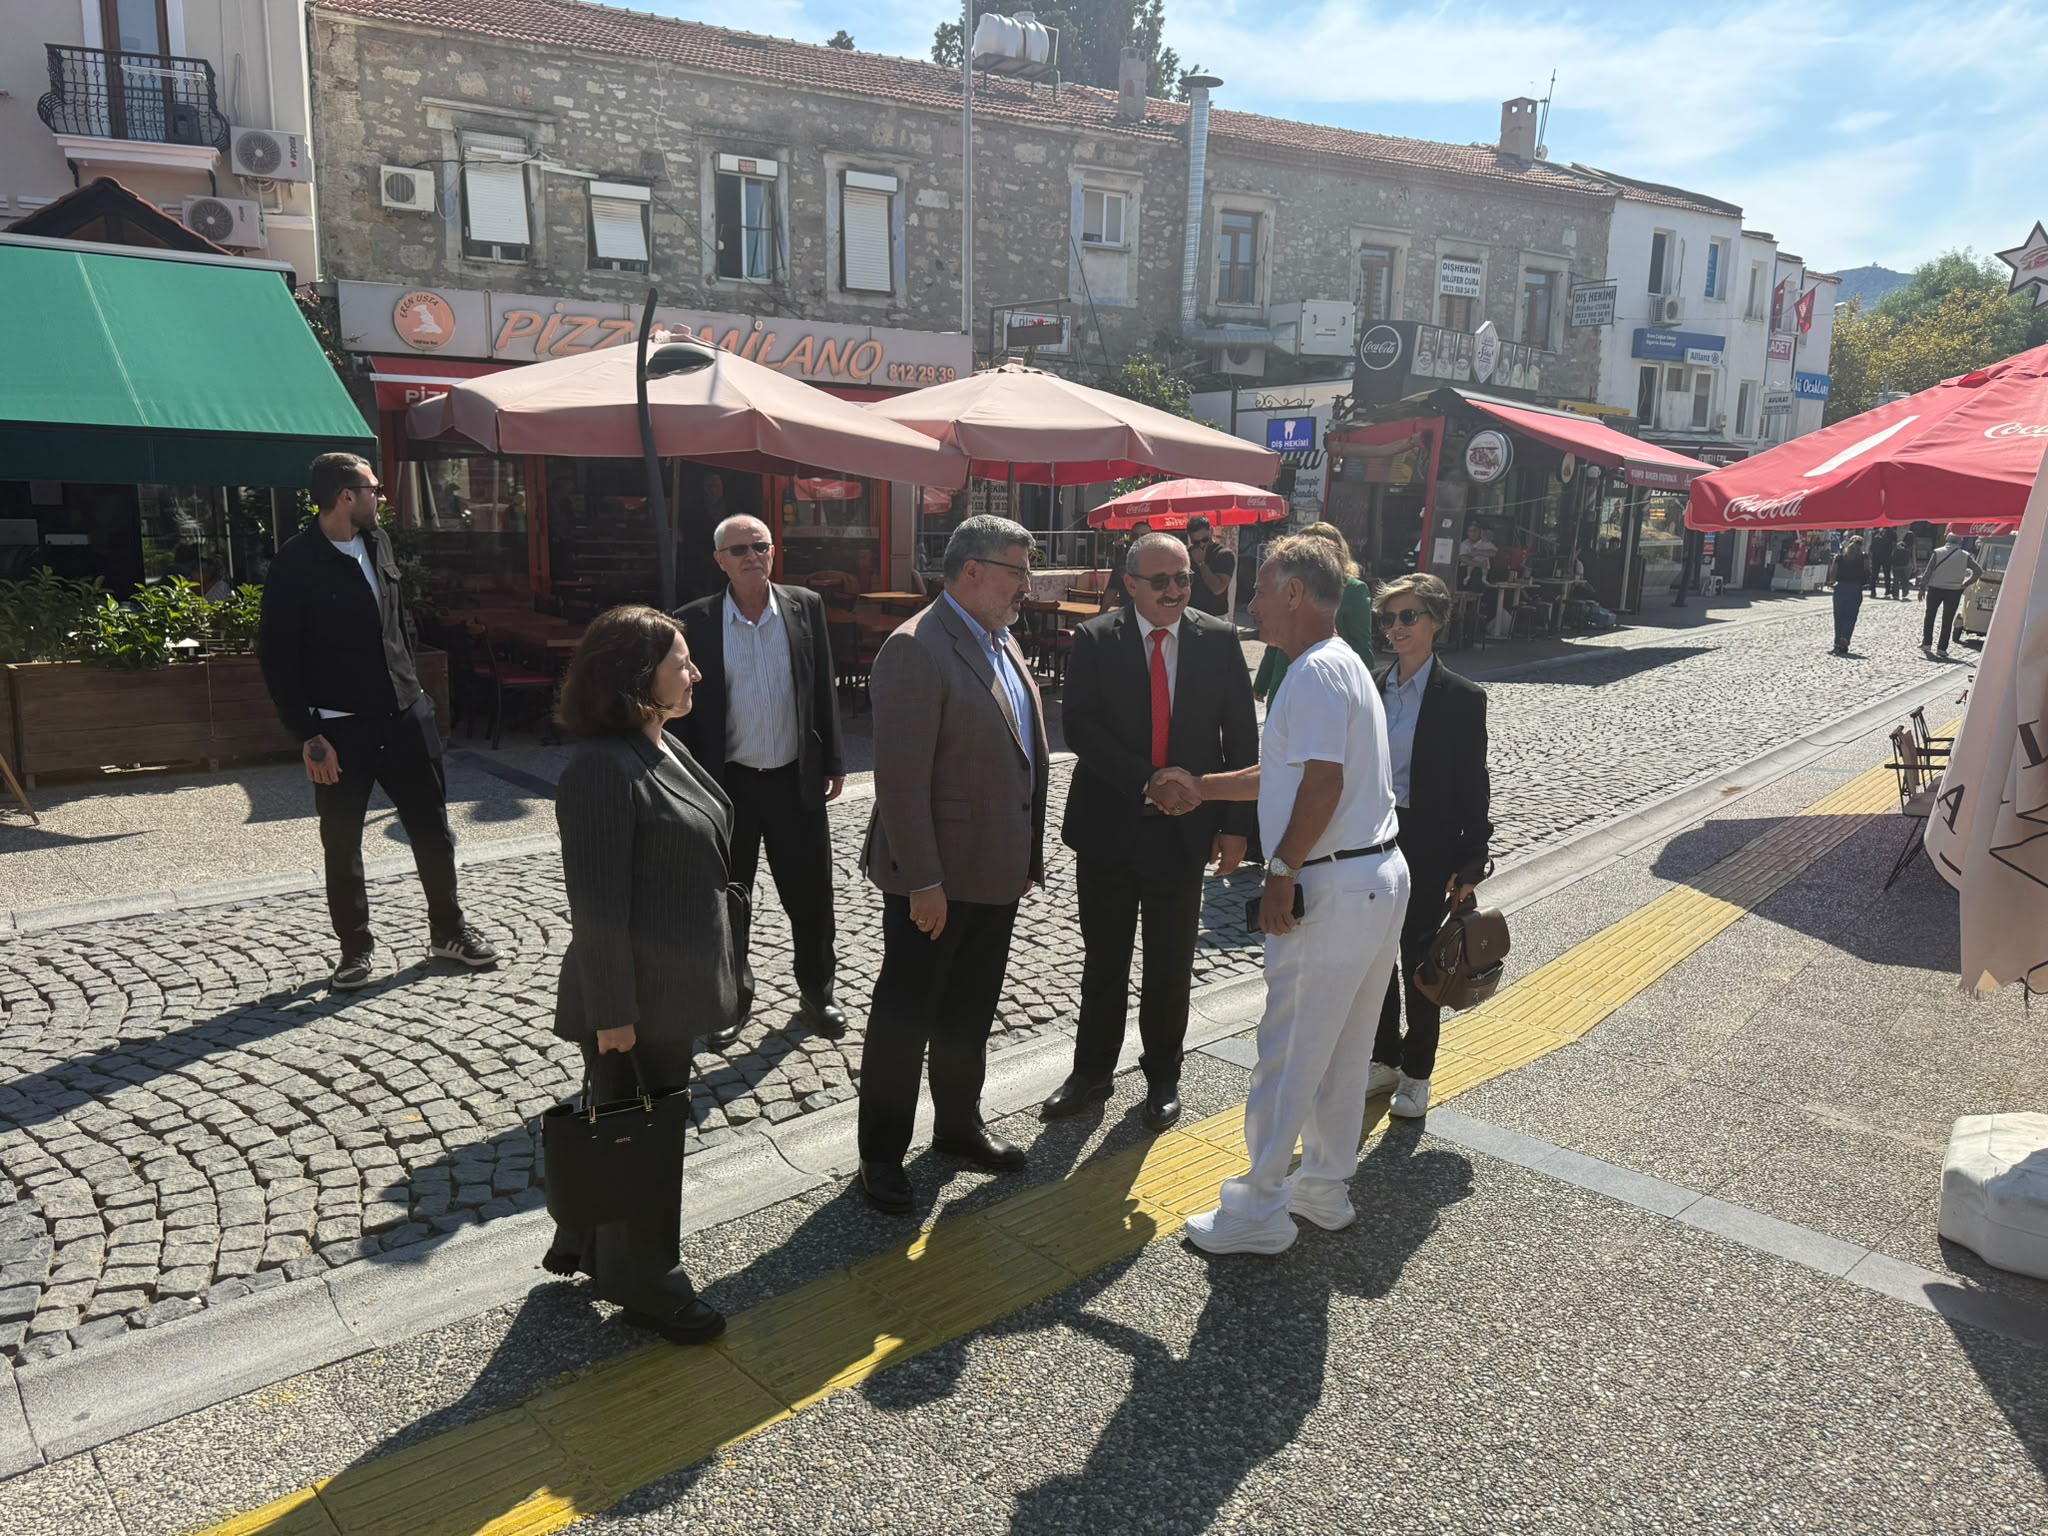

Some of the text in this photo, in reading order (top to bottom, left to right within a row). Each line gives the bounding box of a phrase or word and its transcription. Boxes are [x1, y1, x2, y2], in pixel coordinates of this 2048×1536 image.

[400, 295, 440, 318] EREN USTA
[495, 303, 667, 356] PİZZ
[1363, 340, 1397, 353] Coca-Cola
[1690, 351, 1711, 362] Allianz
[888, 363, 956, 384] 812 29 39
[1271, 438, 1309, 449] DİŞ HEKİMİ
[1723, 489, 1807, 521] Coca-Cola
